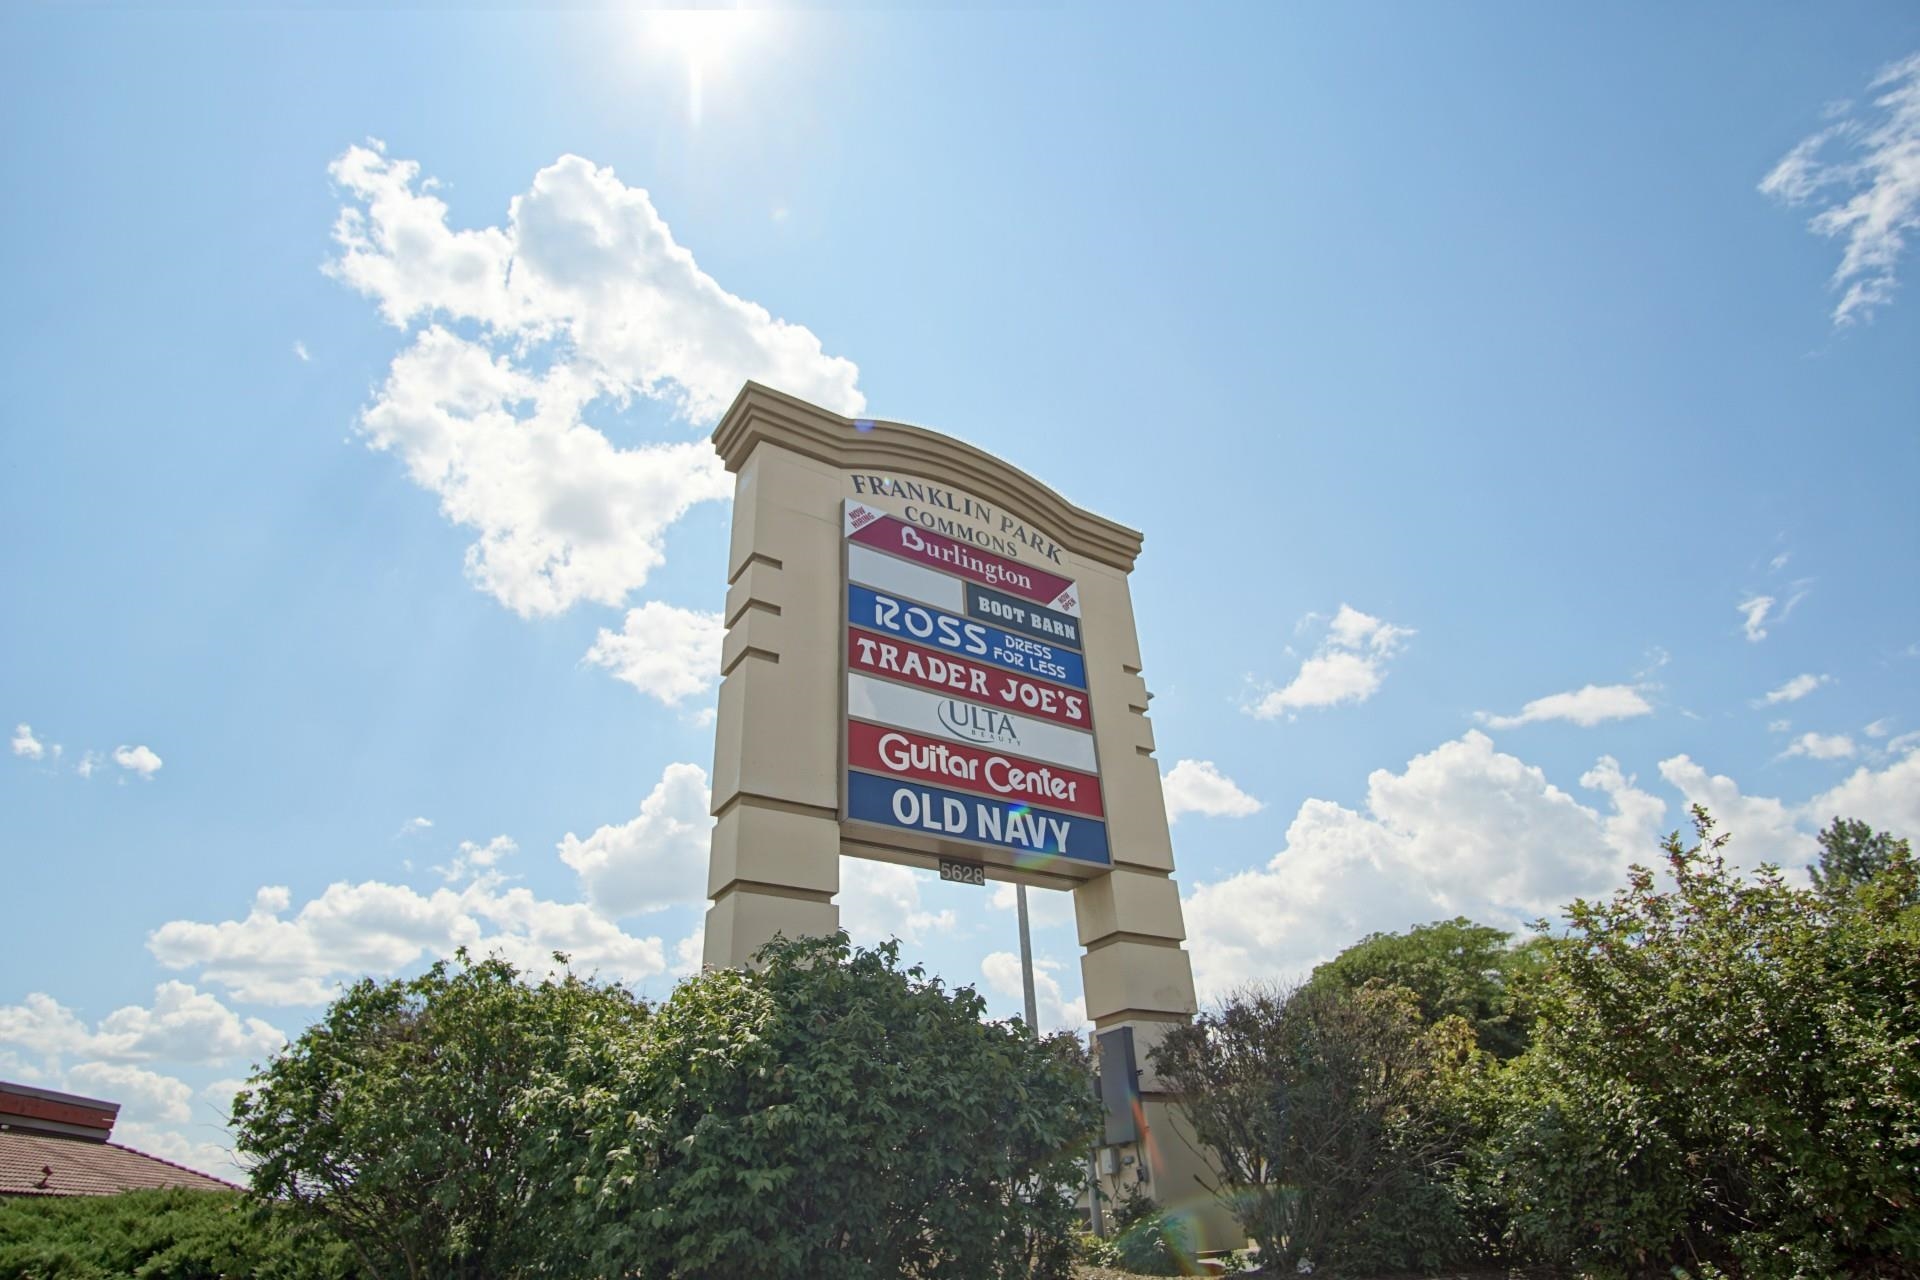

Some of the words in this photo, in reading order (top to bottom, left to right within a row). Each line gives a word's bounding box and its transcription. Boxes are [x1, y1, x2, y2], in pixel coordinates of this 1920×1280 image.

[848, 506, 865, 520] NOW
[851, 474, 991, 524] FRANKLIN
[1000, 512, 1065, 566] PARK
[851, 512, 876, 529] HIRING
[905, 505, 1018, 557] COMMONS
[901, 526, 1032, 590] Burlington
[875, 595, 987, 655] ROSS
[978, 596, 1025, 624] BOOT
[1031, 613, 1075, 640] BARN
[994, 647, 1024, 667] FOR
[1030, 660, 1066, 679] LESS
[1005, 635, 1052, 660] DRESS
[857, 638, 990, 696] TRADER
[1000, 678, 1082, 720] JOE'S
[949, 700, 1016, 739] ULTA
[971, 729, 1021, 747] BEAUTY
[878, 733, 978, 781] Guitar
[984, 756, 1077, 802] Center
[892, 788, 968, 834] OLD
[977, 803, 1070, 854] NAVY
[940, 863, 984, 884] 5628
